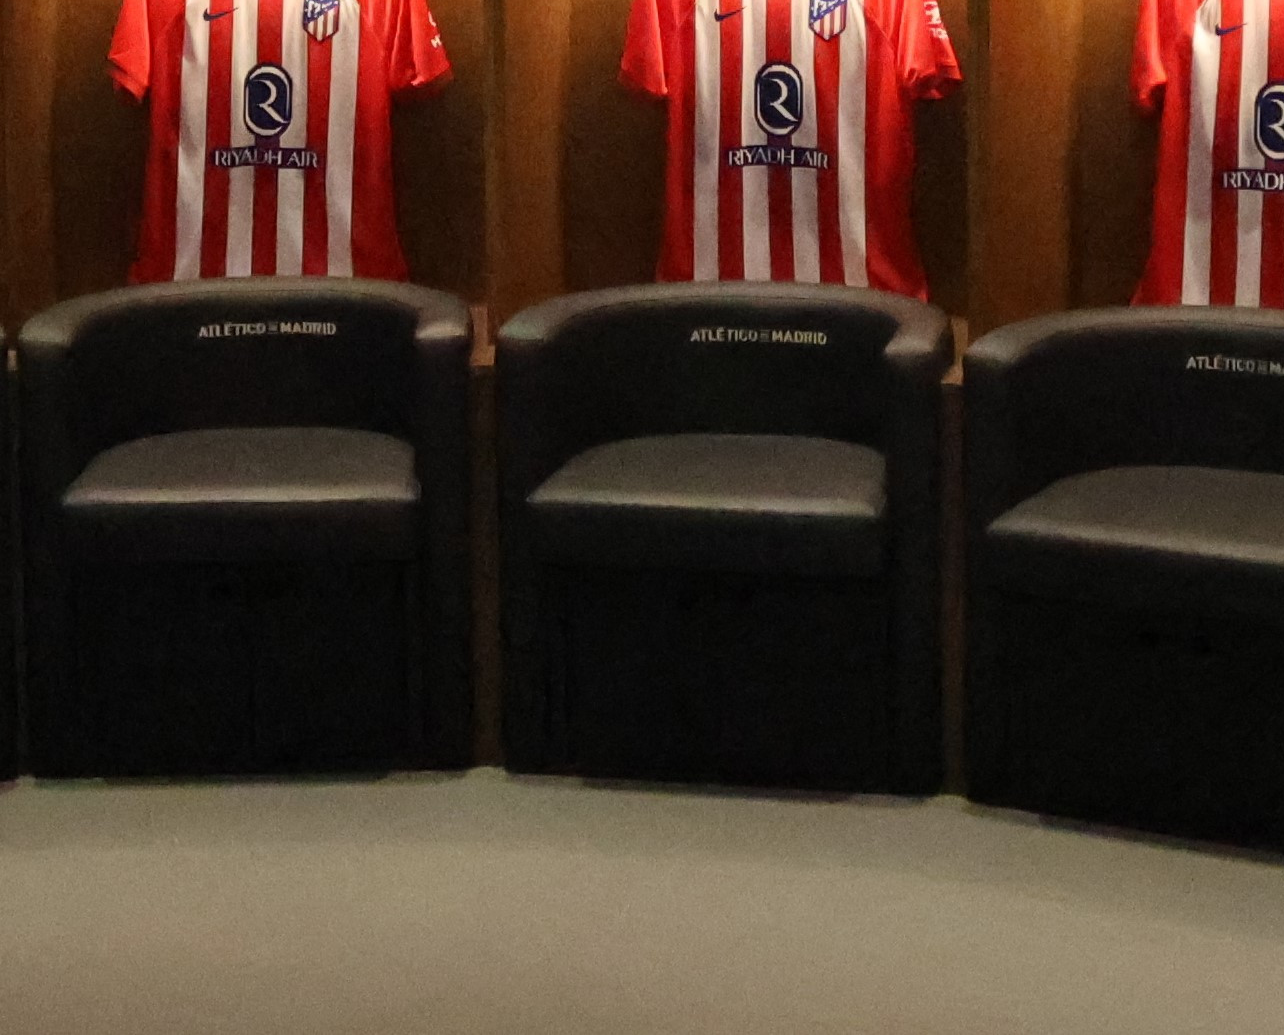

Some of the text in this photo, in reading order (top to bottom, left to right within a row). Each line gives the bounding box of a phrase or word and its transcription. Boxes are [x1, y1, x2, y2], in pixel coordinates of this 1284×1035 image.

[215, 149, 319, 168] RIYADH AIR
[728, 148, 829, 170] RIYADH AIR
[280, 321, 337, 336] MADRID
[690, 326, 758, 343] ATLÉTICO
[771, 329, 828, 345] MADRID
[1186, 354, 1255, 373] ATLÉTICO
